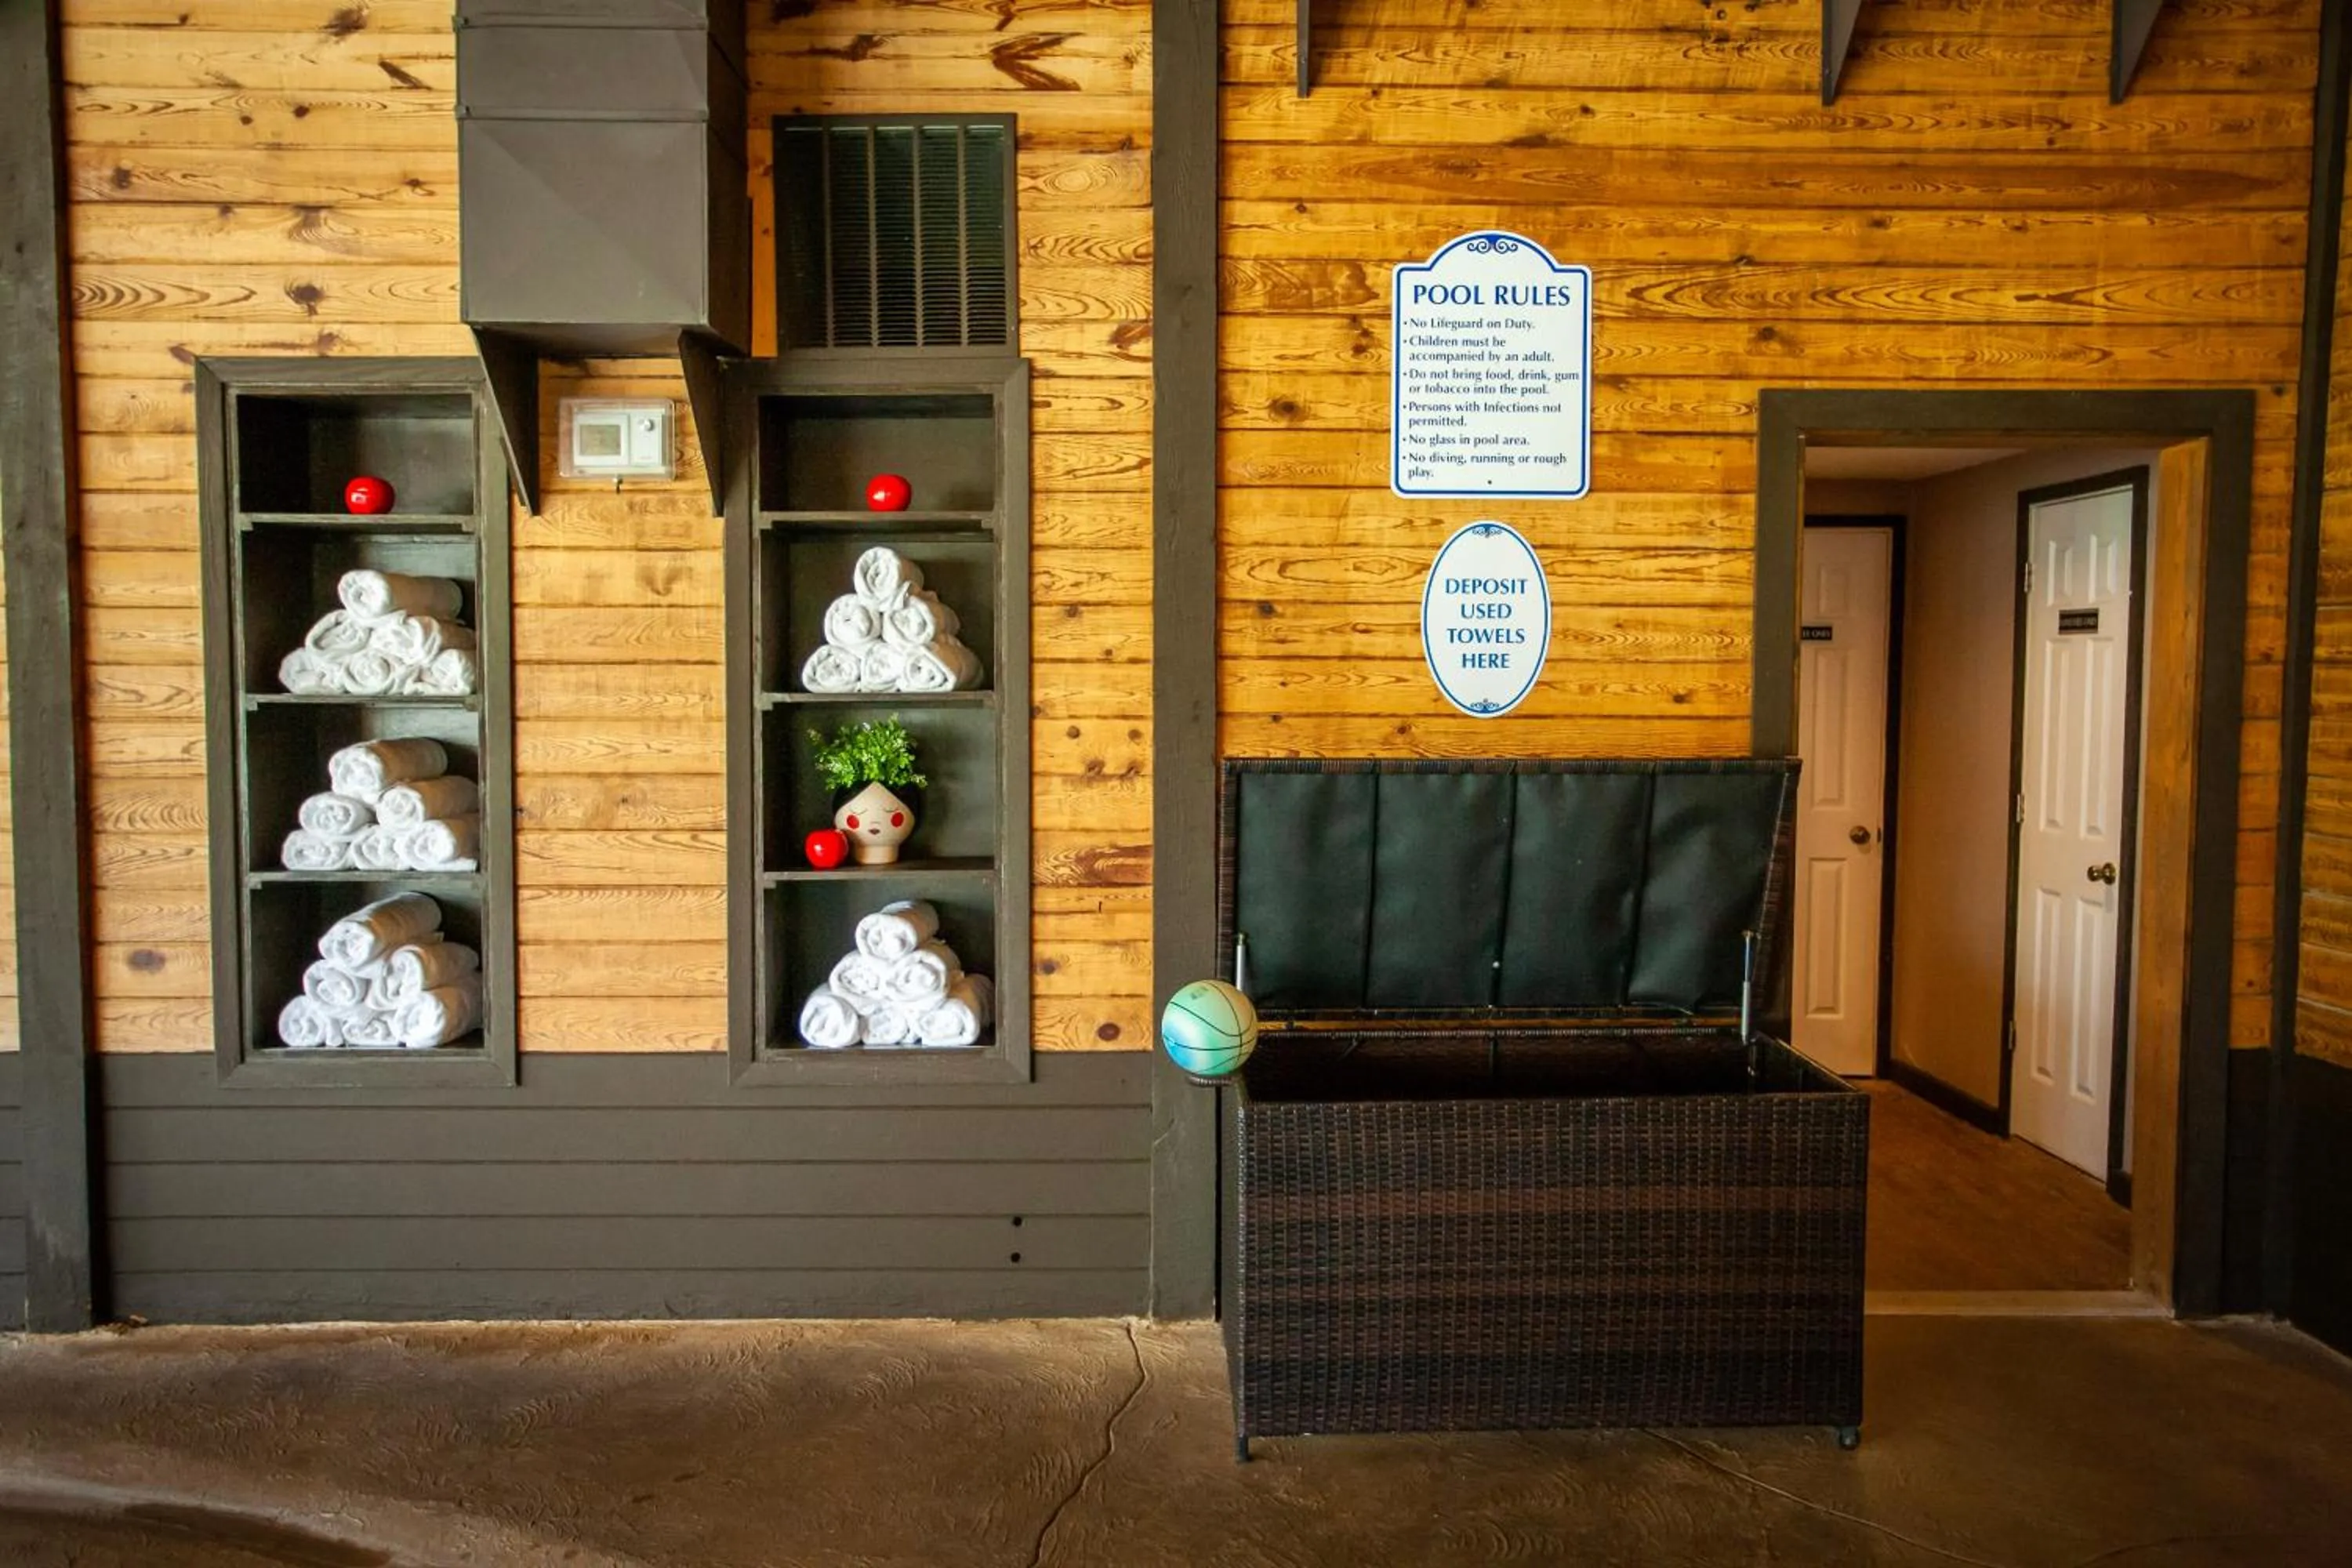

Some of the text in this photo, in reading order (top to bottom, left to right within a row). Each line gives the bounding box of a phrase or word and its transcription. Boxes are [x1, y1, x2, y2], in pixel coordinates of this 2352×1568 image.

[1414, 285, 1570, 307] POOL RULES
[1410, 318, 1427, 328] No
[1431, 318, 1483, 330] Lifeguard
[1505, 318, 1535, 331] Duty.
[1410, 336, 1459, 347] Children
[1493, 336, 1506, 347] be
[1409, 351, 1484, 364] accompanied
[1488, 352, 1501, 363] by
[1522, 351, 1555, 362] adult.
[1410, 368, 1579, 383] Do not bring food, drink, gum
[1425, 384, 1470, 393] tobacco
[1474, 384, 1497, 394] into
[1499, 383, 1518, 394] the
[1520, 383, 1549, 396] pool.
[1409, 401, 1562, 412] Persons with Infections not
[1408, 416, 1467, 428] permitted.
[1409, 434, 1530, 448] No glass in pool area.
[1409, 452, 1426, 462] No
[1429, 452, 1467, 464] diving,
[1470, 453, 1515, 464] running
[1534, 453, 1567, 464] rough
[1407, 466, 1434, 480] play.
[1445, 578, 1528, 595] DEPOSIT
[1461, 603, 1512, 619] USED
[1446, 627, 1526, 644] TOWELS
[1461, 653, 1510, 669] HERE
